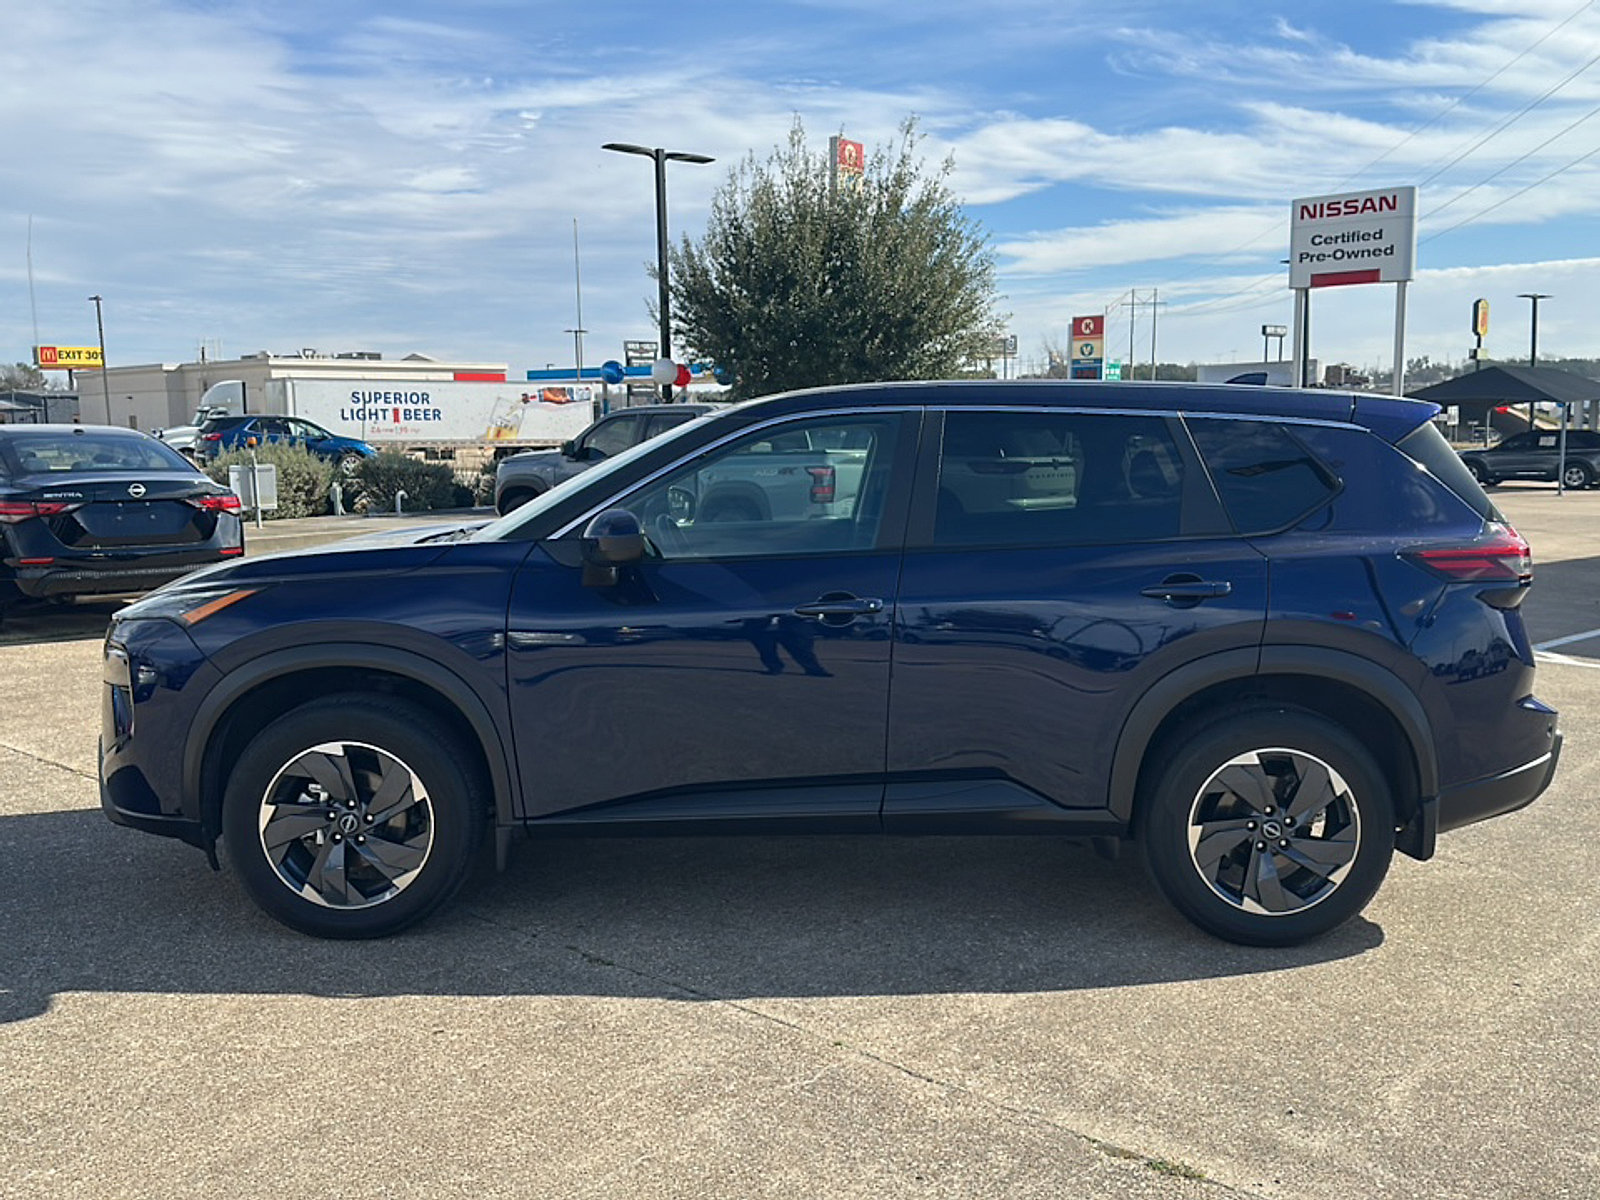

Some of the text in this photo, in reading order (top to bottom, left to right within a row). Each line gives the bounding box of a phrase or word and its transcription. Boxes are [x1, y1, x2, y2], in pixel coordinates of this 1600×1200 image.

[1300, 194, 1397, 220] NISSAN
[1311, 228, 1384, 247] Certified
[1299, 244, 1395, 263] Pre-Owned
[58, 350, 83, 360] EXIT
[351, 391, 431, 405] SUPERIOR
[341, 408, 442, 421] LIGHT BEER
